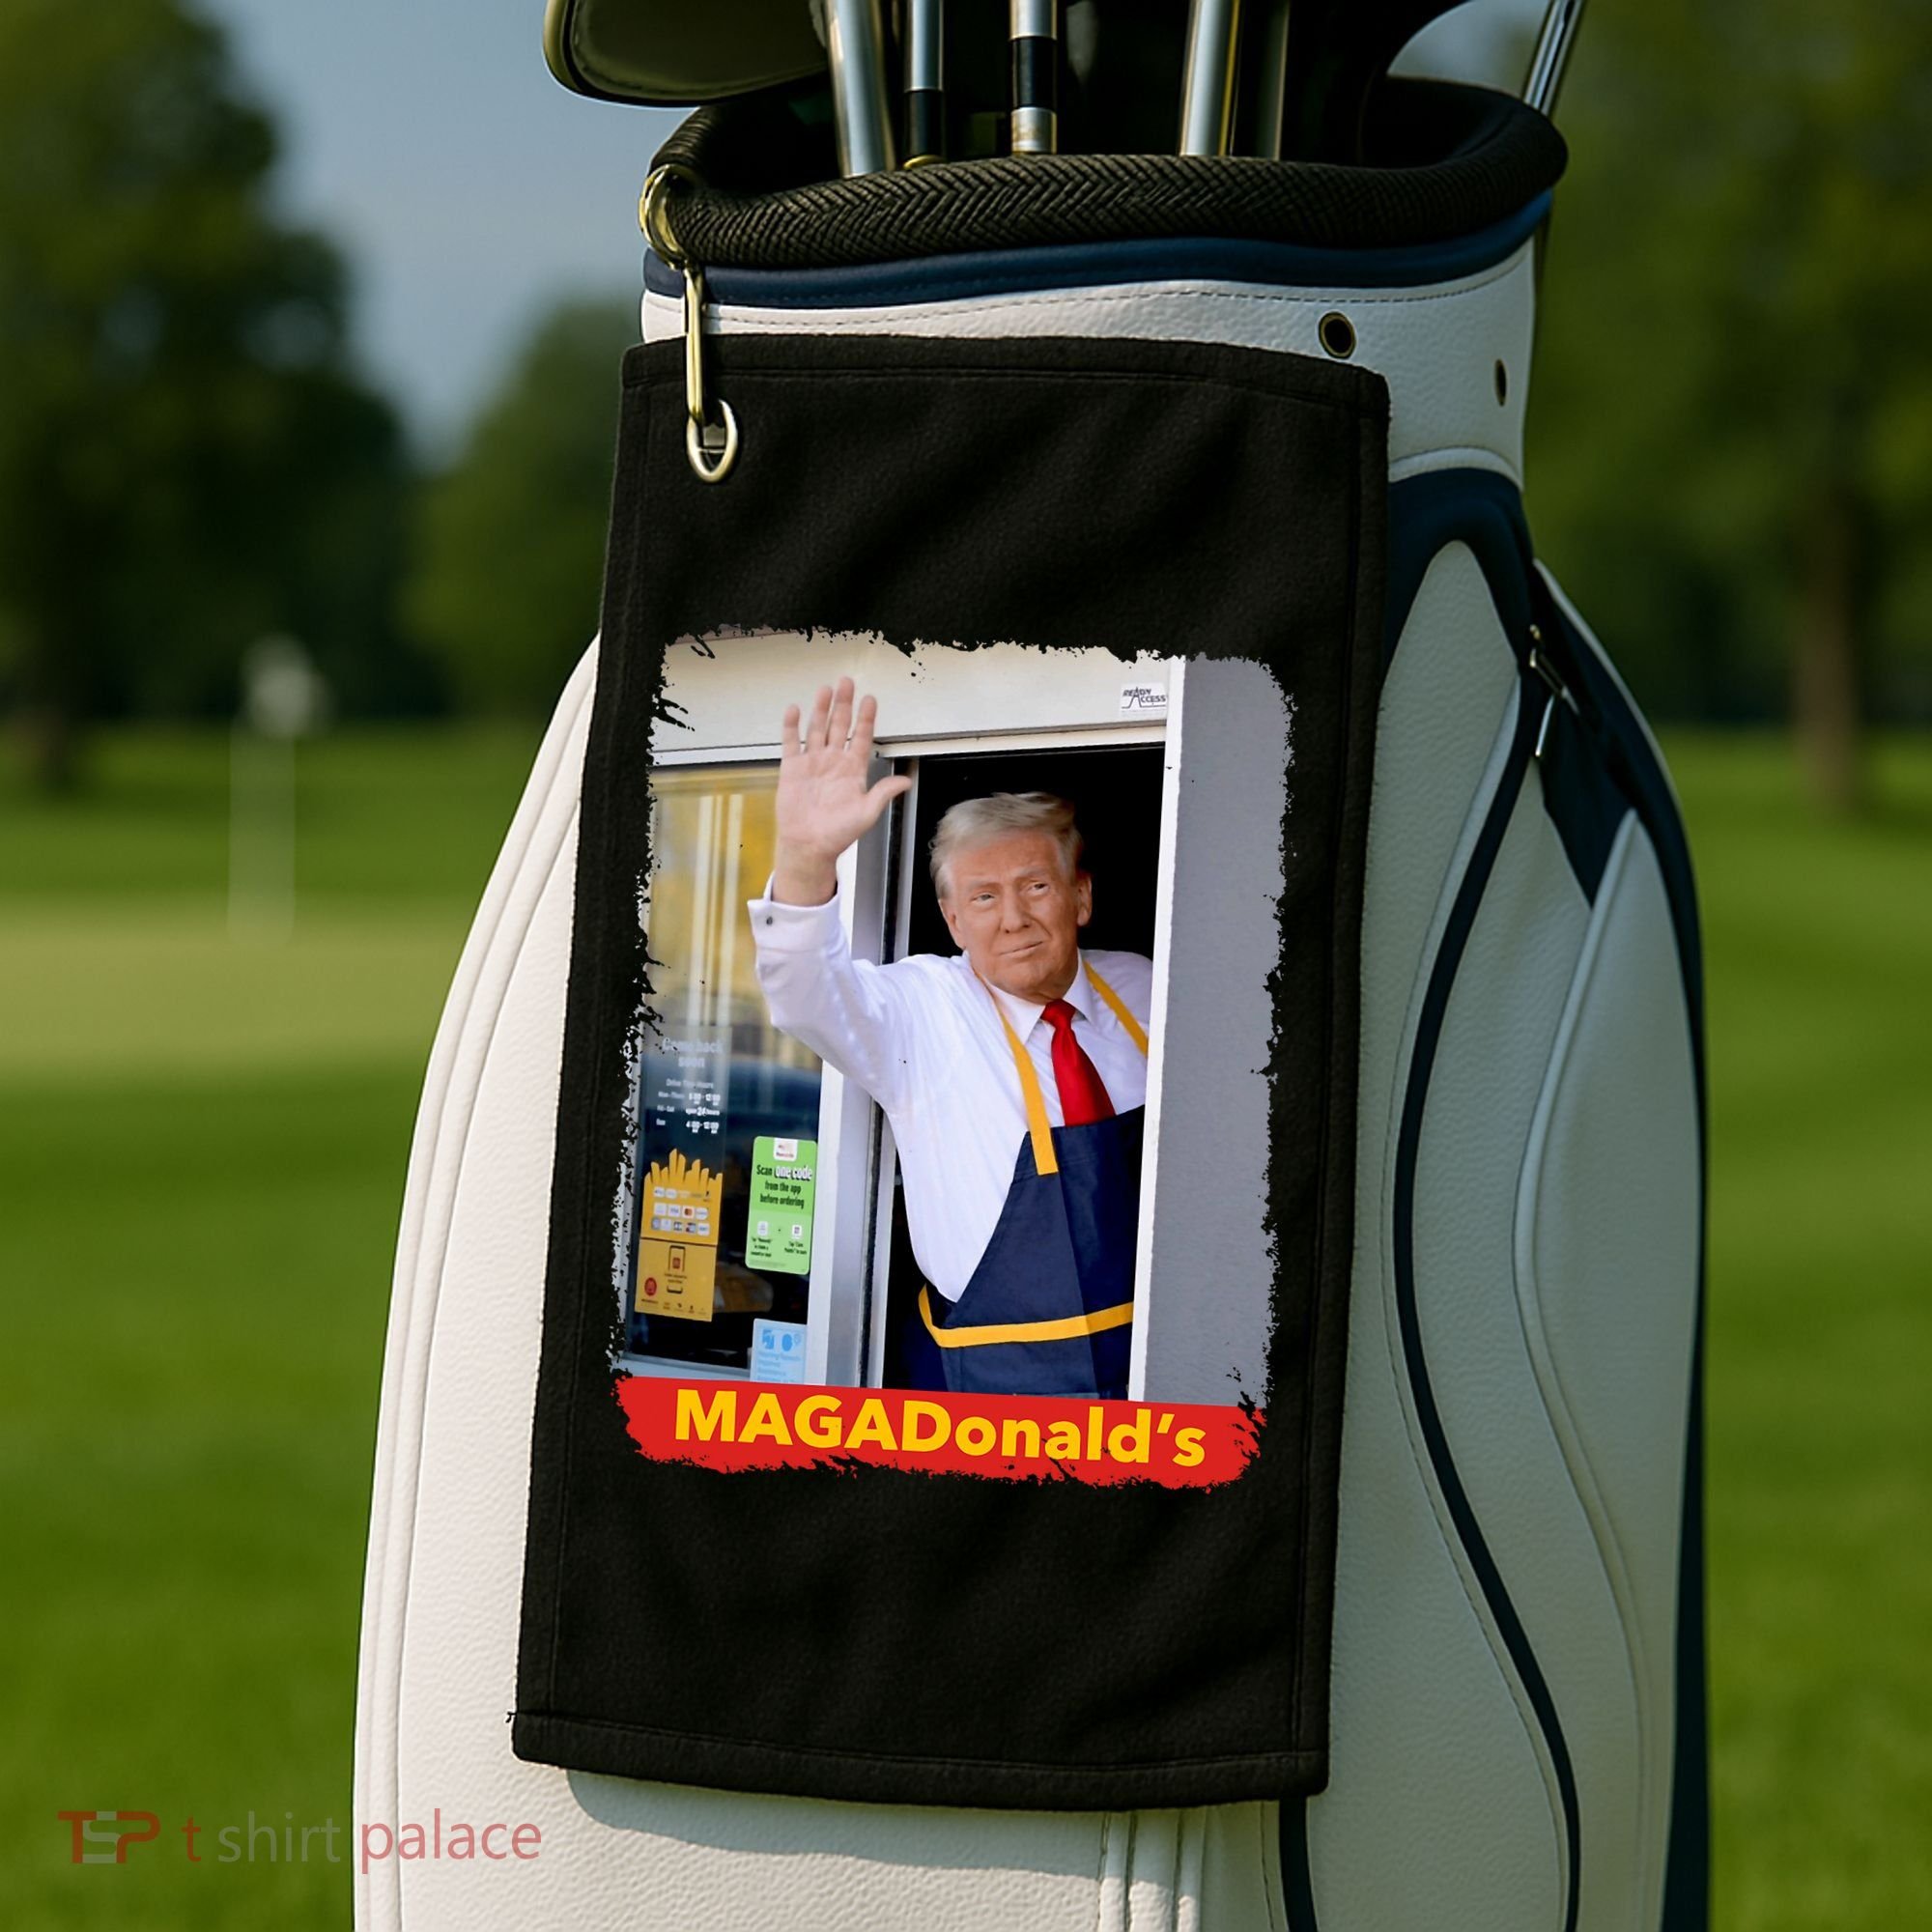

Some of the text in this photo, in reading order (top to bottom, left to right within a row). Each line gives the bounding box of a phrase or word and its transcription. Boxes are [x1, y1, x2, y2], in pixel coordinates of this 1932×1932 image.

[756, 1164, 773, 1176] Scan
[764, 1179, 802, 1196] from the app
[759, 1193, 805, 1209] before ordering
